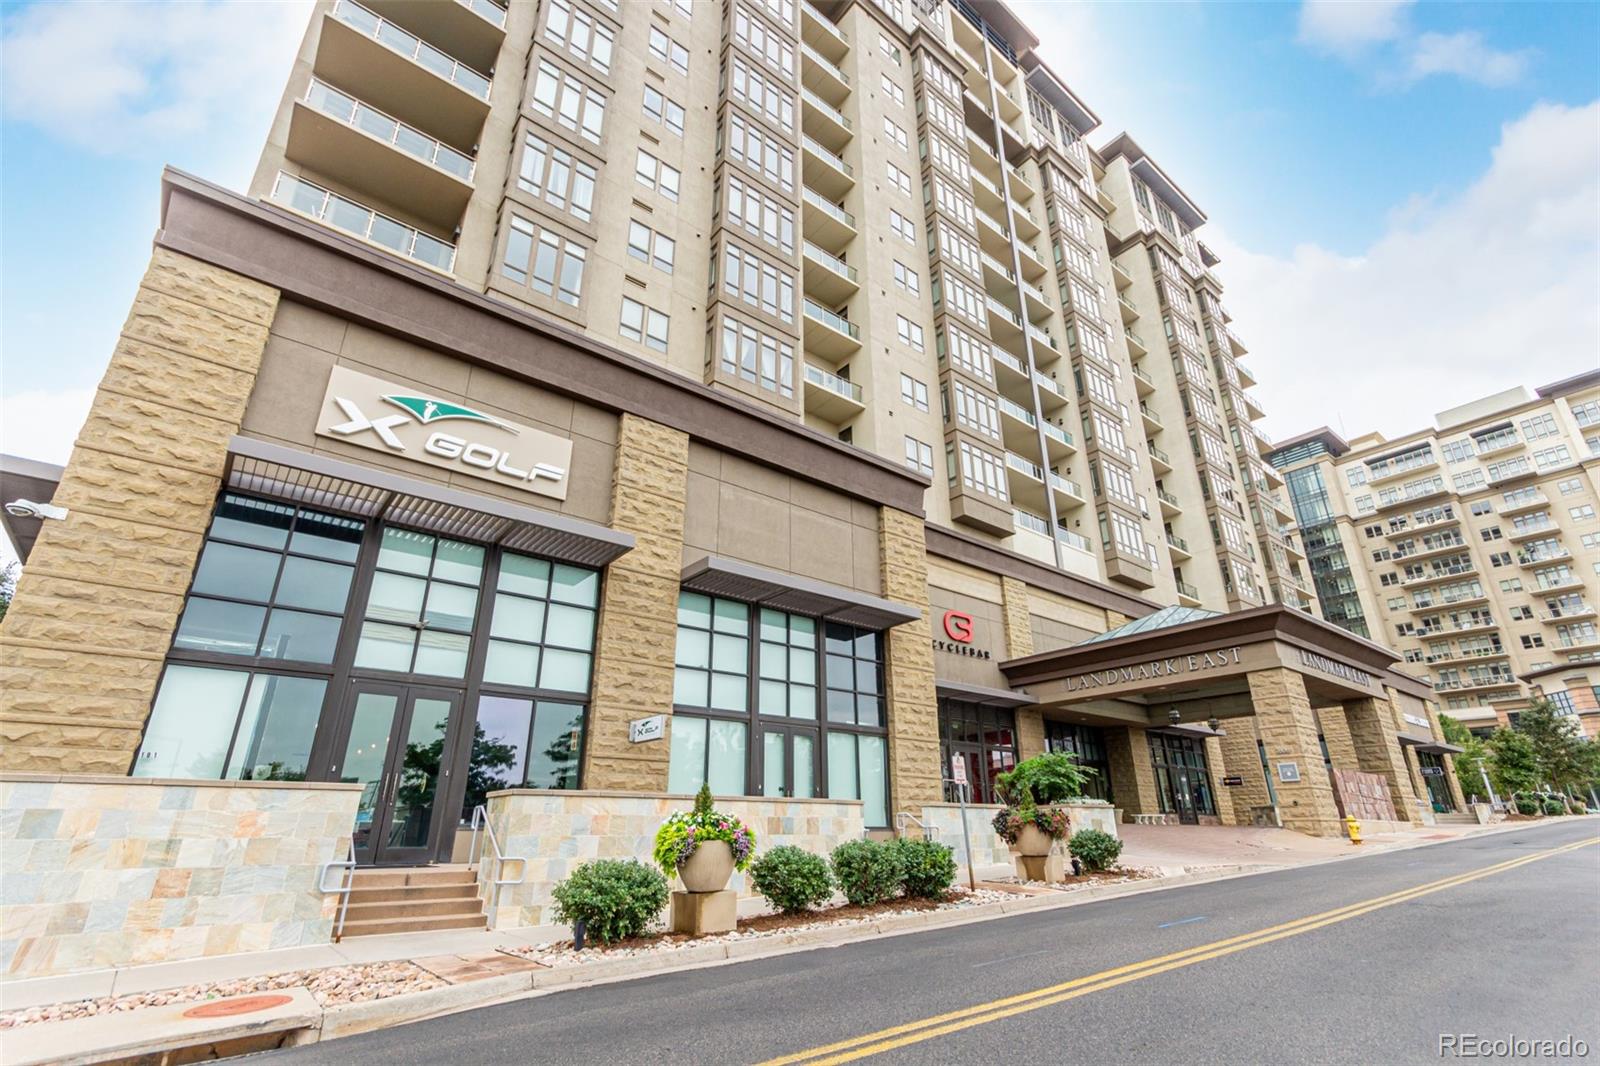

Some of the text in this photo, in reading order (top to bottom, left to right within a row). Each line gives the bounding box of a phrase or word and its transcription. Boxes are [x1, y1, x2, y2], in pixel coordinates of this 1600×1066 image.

[328, 396, 566, 482] X GOLF
[1066, 646, 1241, 692] LANDMARK EAST
